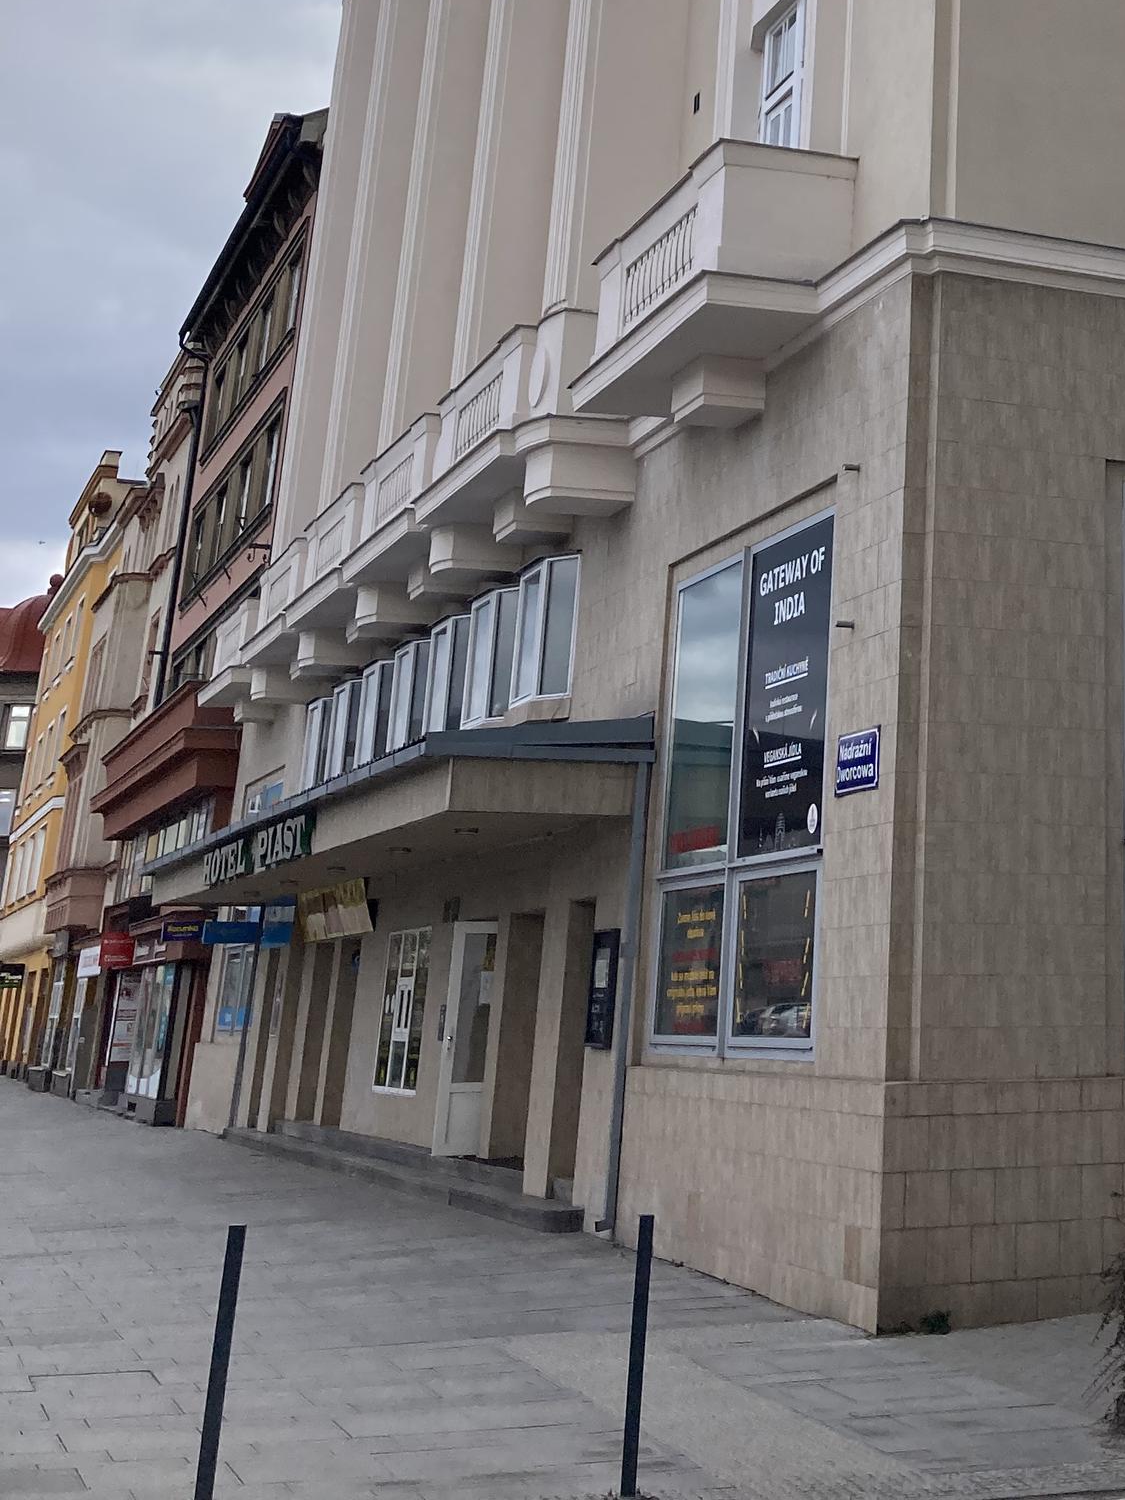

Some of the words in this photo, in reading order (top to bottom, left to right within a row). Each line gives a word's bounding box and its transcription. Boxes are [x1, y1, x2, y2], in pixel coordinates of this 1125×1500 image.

[760, 553, 809, 597] GATEWAY
[810, 546, 826, 574] OF
[773, 591, 805, 626] INDIA
[836, 763, 874, 784] Dworcowa
[203, 838, 245, 886] HOTEL
[252, 815, 306, 874] PIAST
